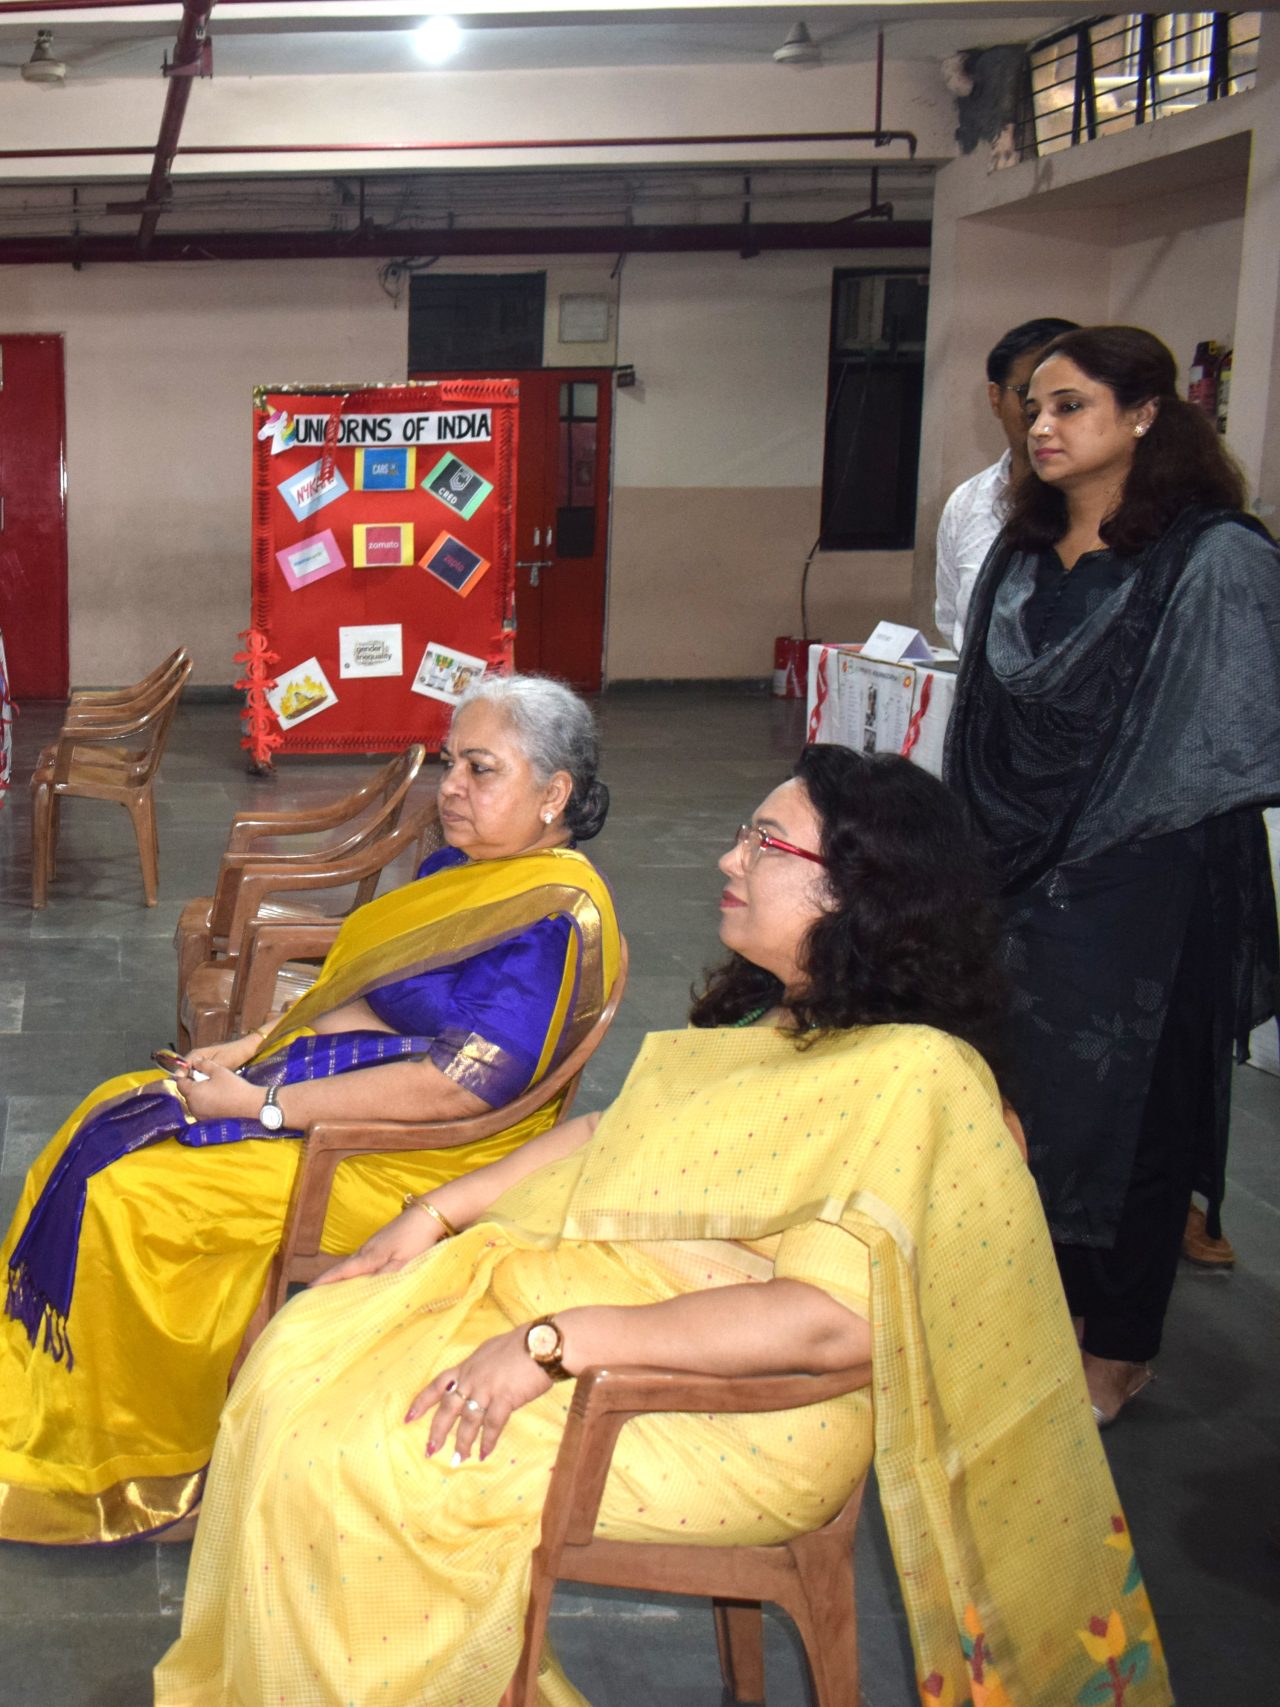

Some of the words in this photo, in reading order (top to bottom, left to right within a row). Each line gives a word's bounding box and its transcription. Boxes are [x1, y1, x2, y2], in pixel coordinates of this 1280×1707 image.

[403, 416, 429, 442] OF
[437, 413, 490, 440] INDIA
[438, 487, 458, 505] CRED
[368, 540, 399, 550] zomato
